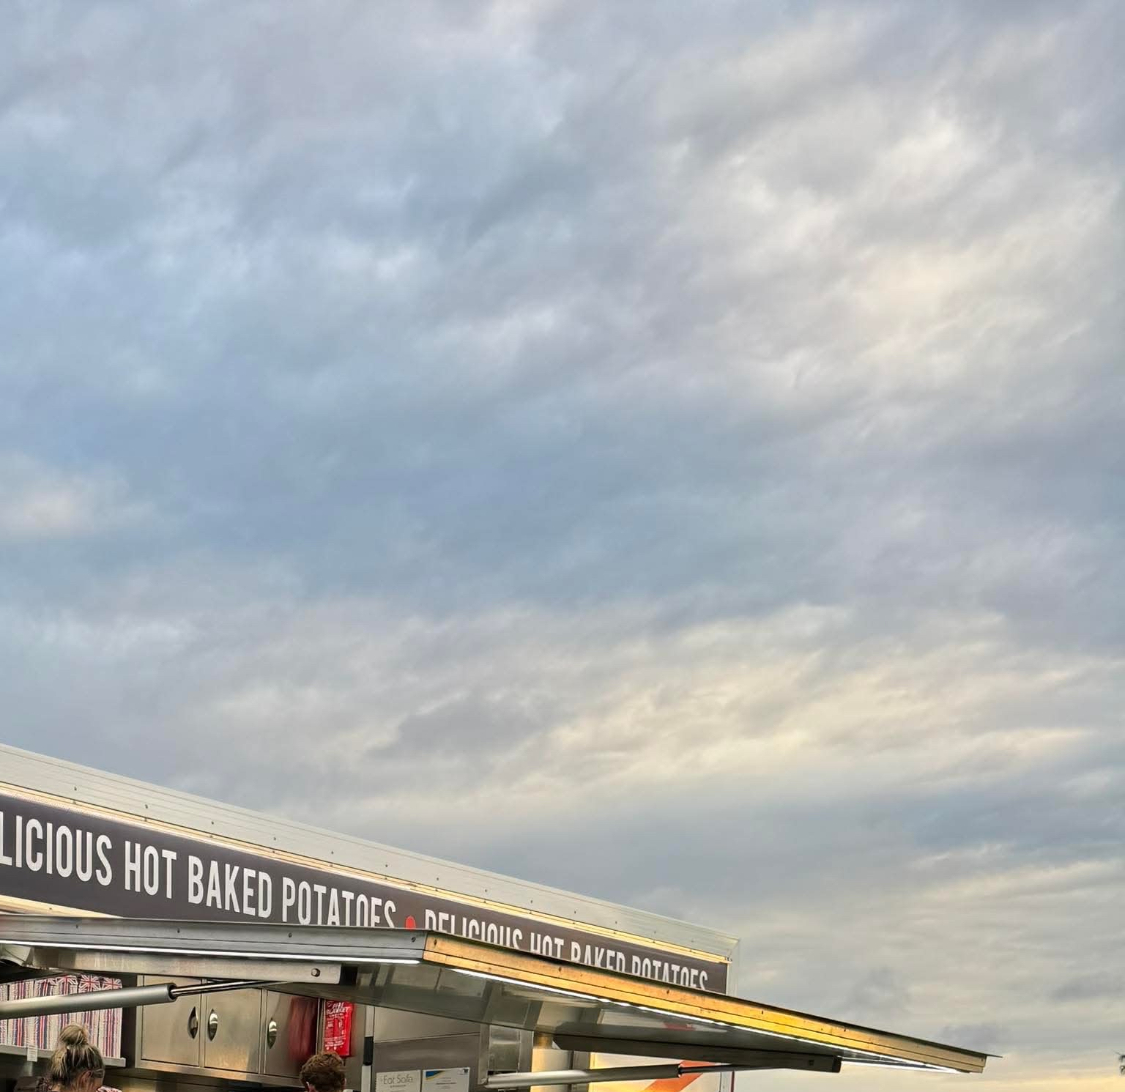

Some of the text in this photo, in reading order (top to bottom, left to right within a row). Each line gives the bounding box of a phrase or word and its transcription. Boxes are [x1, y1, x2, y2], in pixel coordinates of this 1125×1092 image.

[124, 842, 176, 899] HOT
[188, 856, 272, 919] BAKED
[282, 877, 397, 929] POTATOES
